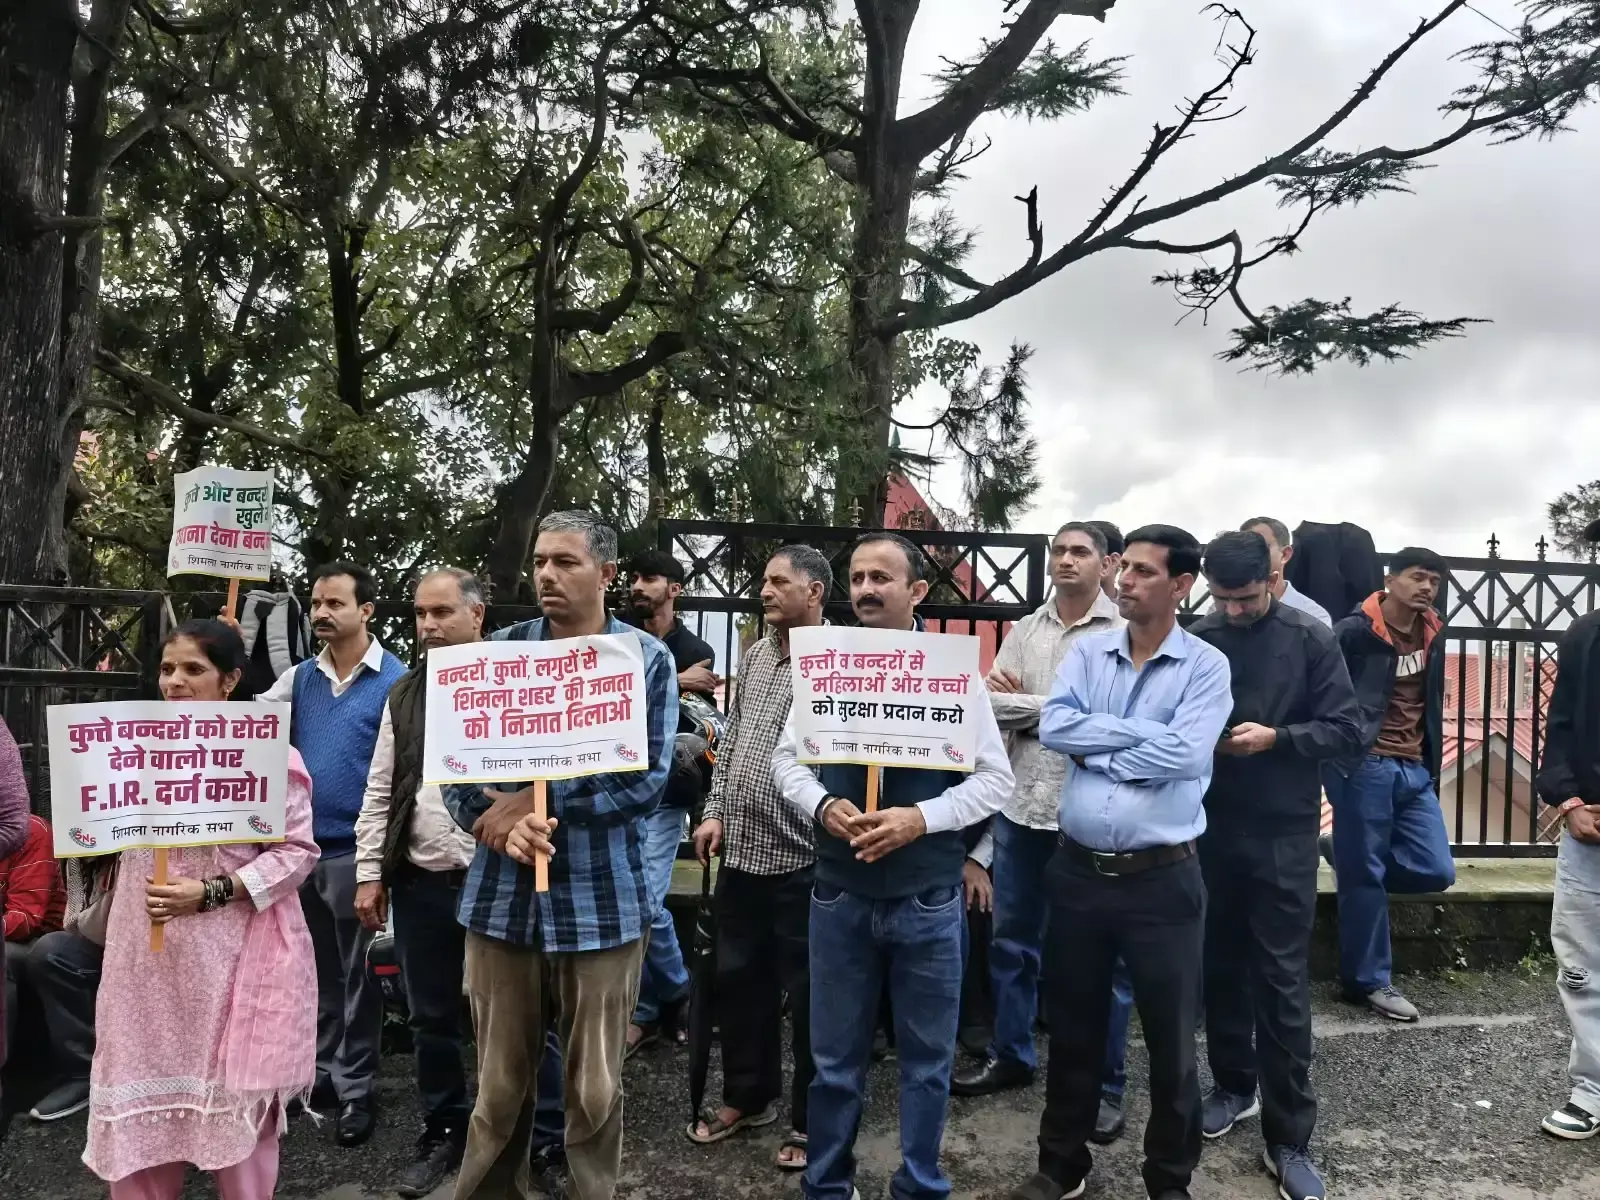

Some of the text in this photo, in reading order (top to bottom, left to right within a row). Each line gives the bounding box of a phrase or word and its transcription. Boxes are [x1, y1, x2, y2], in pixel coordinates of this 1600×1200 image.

[203, 481, 233, 503] और
[236, 503, 264, 529] खुले
[210, 521, 240, 548] देना
[188, 555, 216, 567] शिमला
[220, 560, 254, 571] नागरिक
[581, 645, 598, 670] से
[798, 649, 925, 679] कुत्तों व बन्दरों से
[453, 672, 633, 712] शिमला शहर की जनता
[812, 671, 970, 694] महिलाओं और बच्चों
[463, 693, 632, 739] को निजात दिलाओ
[812, 695, 964, 724] को सुरक्षा प्रदान करो
[68, 714, 279, 753] कुत्ते बन्दरों को रोटी
[108, 744, 244, 771] देने वालो पर
[618, 745, 638, 760] SNS
[832, 738, 931, 757] शिमला नागरिक सभा
[946, 747, 964, 762] SNS
[447, 757, 468, 773] SNS
[481, 752, 601, 770] शिमला नागरिक सभा
[81, 780, 148, 812] F.I.R.
[155, 773, 203, 805] दर्ज
[112, 822, 233, 840] शिमला नागरिक सभा
[252, 816, 272, 833] SNS
[75, 830, 96, 846] SNS
